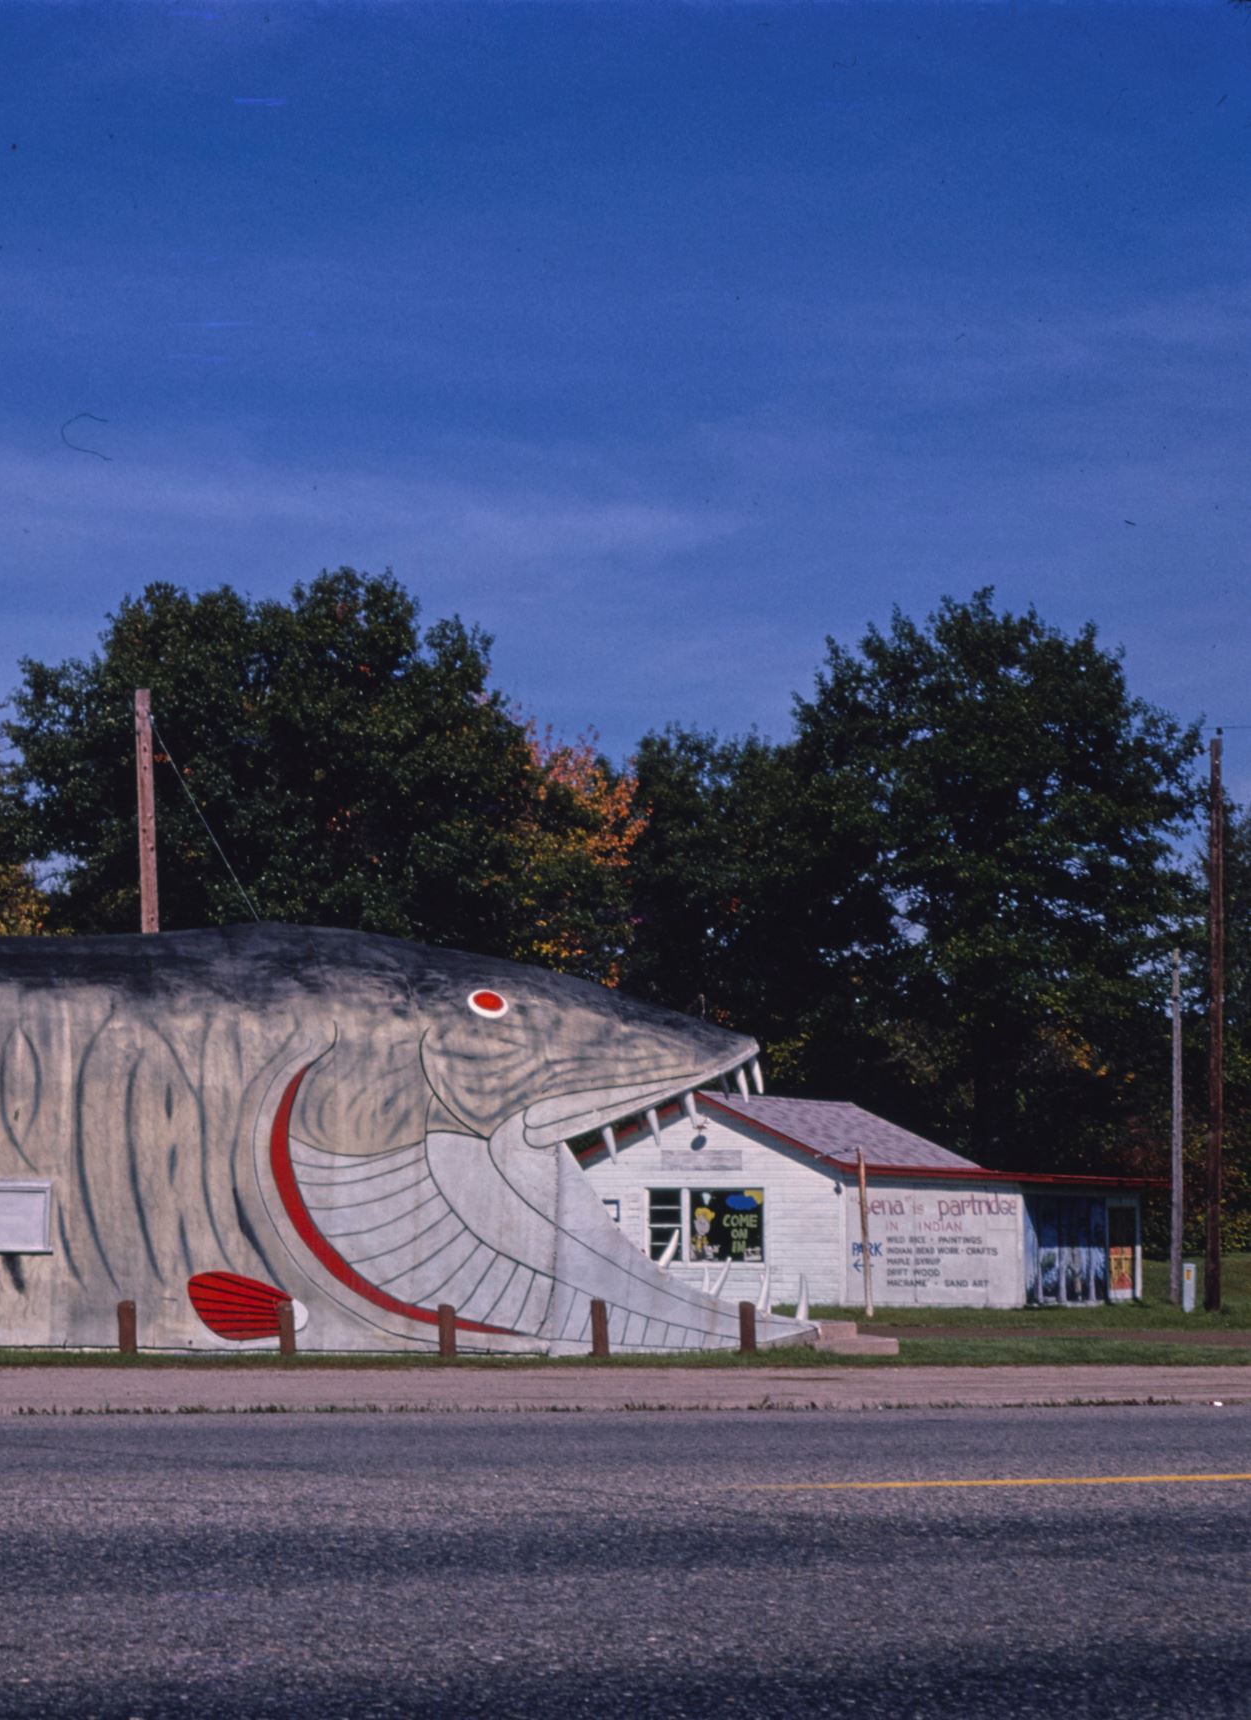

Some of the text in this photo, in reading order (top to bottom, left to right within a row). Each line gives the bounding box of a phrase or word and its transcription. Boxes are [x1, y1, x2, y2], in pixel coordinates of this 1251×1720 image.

[722, 1213, 758, 1228] COME
[885, 1220, 963, 1232] IN INDIAN
[731, 1228, 748, 1239] ON
[886, 1236, 983, 1244] WILD RICE PAINTINGS
[731, 1240, 747, 1253] IN
[852, 1241, 883, 1257] PARK
[886, 1247, 913, 1255] INDIAN
[937, 1247, 959, 1255] WORK
[966, 1247, 998, 1256] CRAFTS
[886, 1268, 940, 1277] DRIFT WOOD
[944, 1279, 968, 1287] SAND
[972, 1279, 990, 1287] ART
